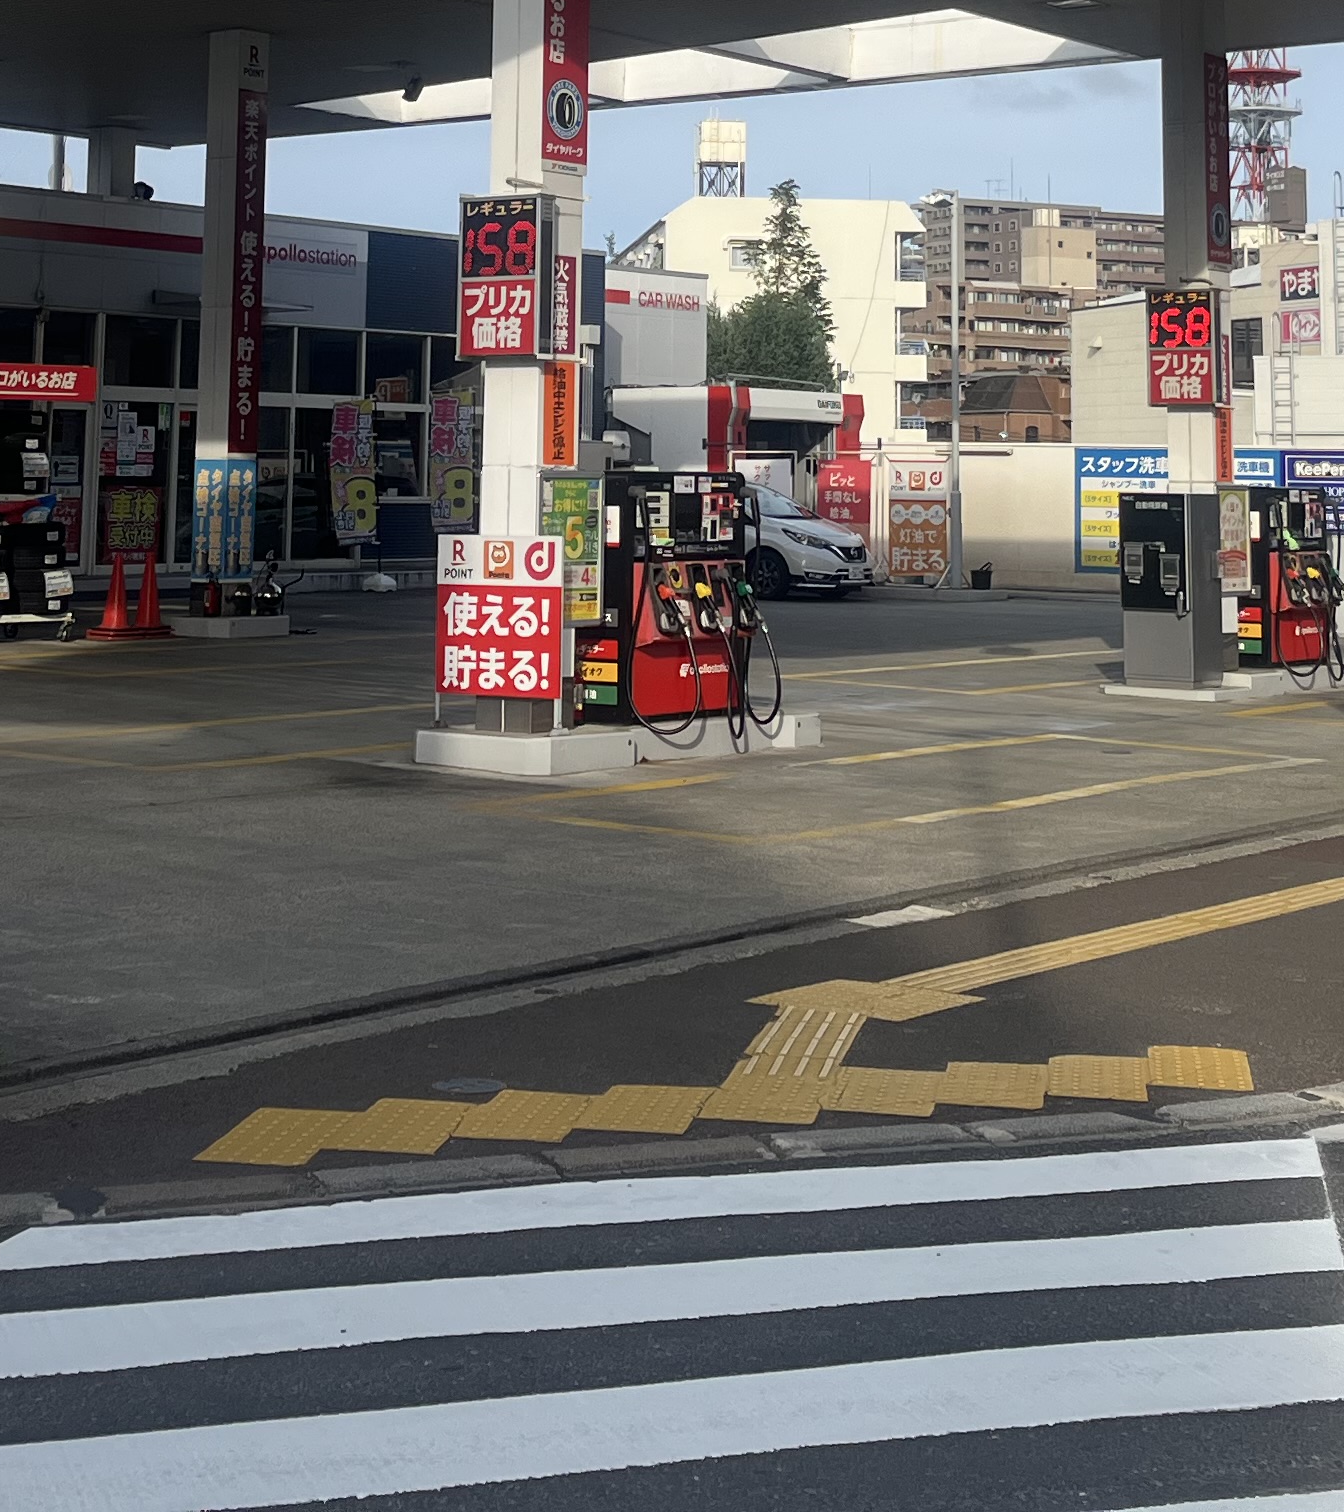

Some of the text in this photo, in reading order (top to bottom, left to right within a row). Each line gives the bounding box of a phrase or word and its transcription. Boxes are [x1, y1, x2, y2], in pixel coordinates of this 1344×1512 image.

[243, 67, 265, 79] POINT
[467, 200, 535, 218] レギュラー
[263, 243, 357, 268] pollostation
[465, 220, 536, 277] 158
[463, 286, 532, 317] プリカ
[637, 291, 700, 311] CAR WASH
[1150, 292, 1209, 305] レギュラー
[471, 317, 523, 350] 価格
[1149, 307, 1211, 349] 158
[1152, 353, 1210, 376] プリカ
[1159, 376, 1203, 399] 価格
[1237, 461, 1271, 473] 洗車機
[829, 473, 856, 488] ピッと
[108, 490, 158, 523] 車検
[823, 490, 862, 504] 手間なし
[108, 524, 155, 550] 受付中
[564, 515, 584, 559] 5
[899, 529, 937, 544] 灯油で
[891, 548, 945, 572] 貯まる
[443, 567, 474, 580] POINT
[444, 592, 549, 636] 使える!
[443, 645, 549, 691] 貯まる!
